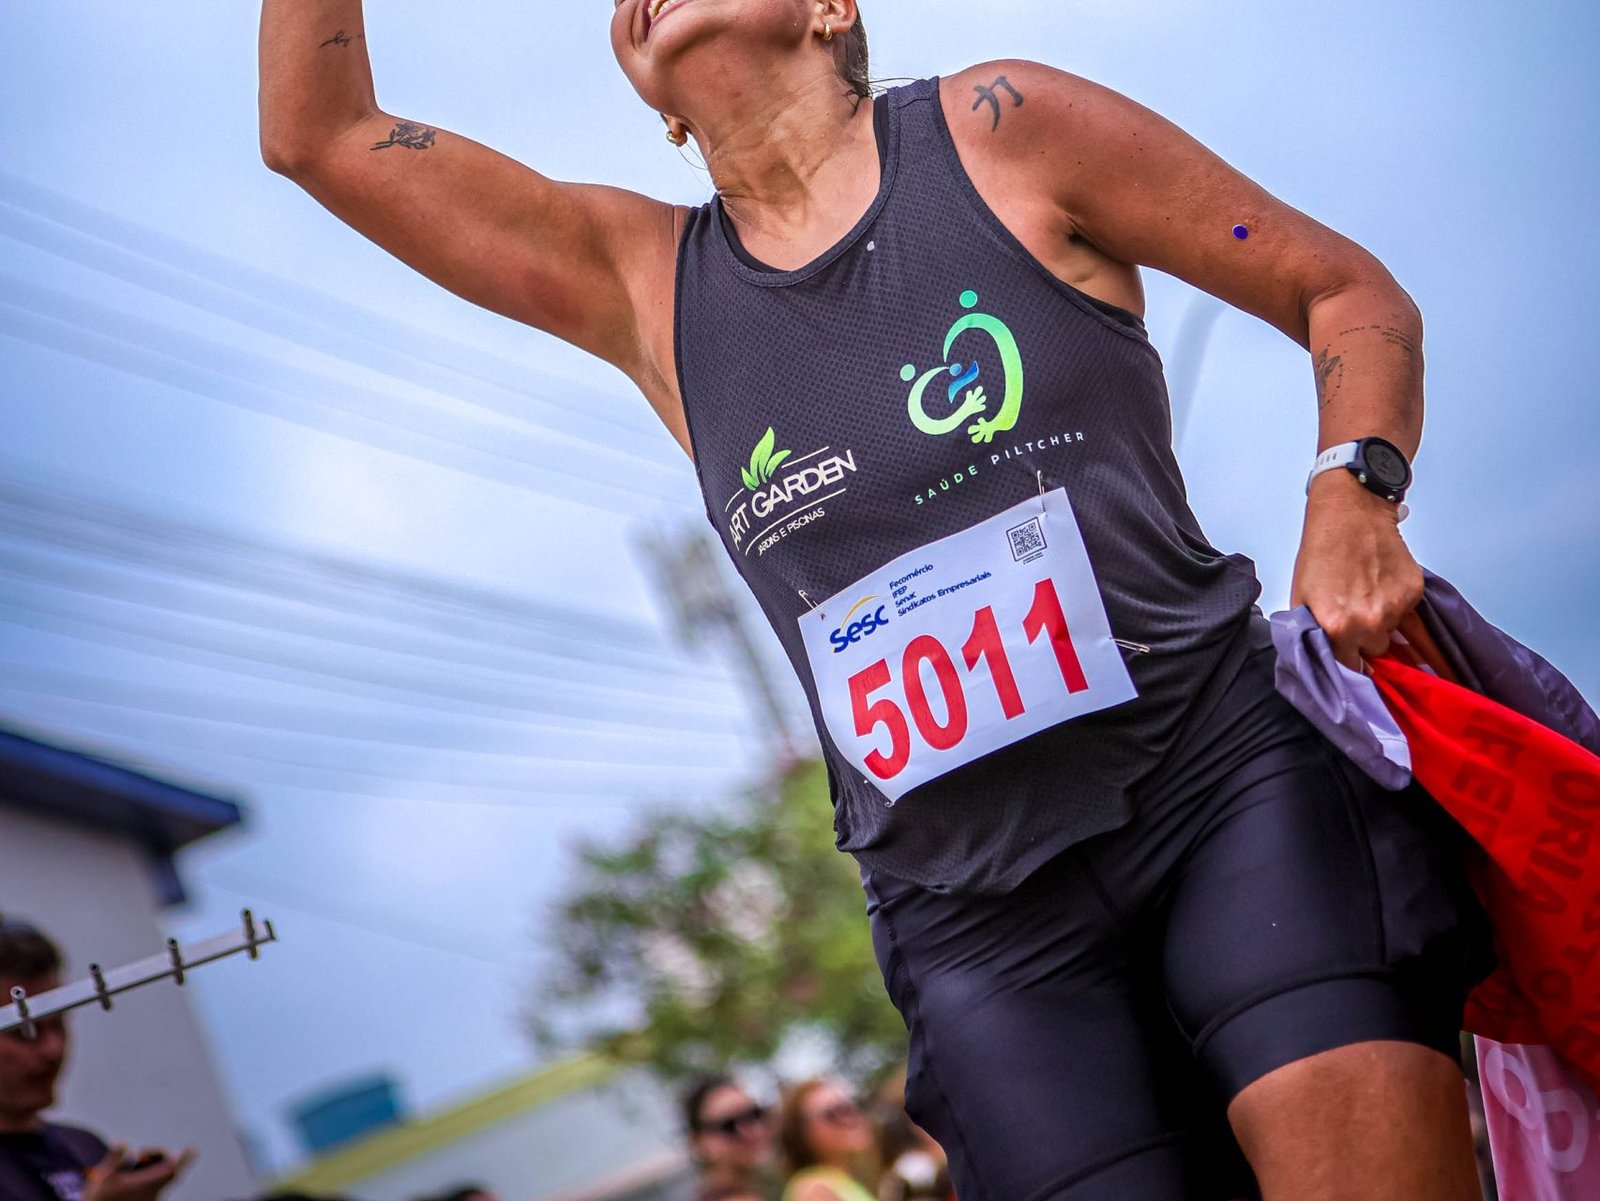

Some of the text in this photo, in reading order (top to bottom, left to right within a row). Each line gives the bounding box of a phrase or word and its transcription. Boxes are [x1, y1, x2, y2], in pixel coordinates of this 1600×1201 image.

[914, 431, 1085, 505] SAÚDE PILTCHER
[729, 449, 857, 552] ART GARDEN
[779, 527, 788, 538] E
[786, 507, 825, 533] PISCINAS
[889, 563, 934, 590] Fecomércio
[892, 585, 908, 599] IFEP
[937, 570, 992, 598] Empresariais
[847, 578, 1090, 781] 5011
